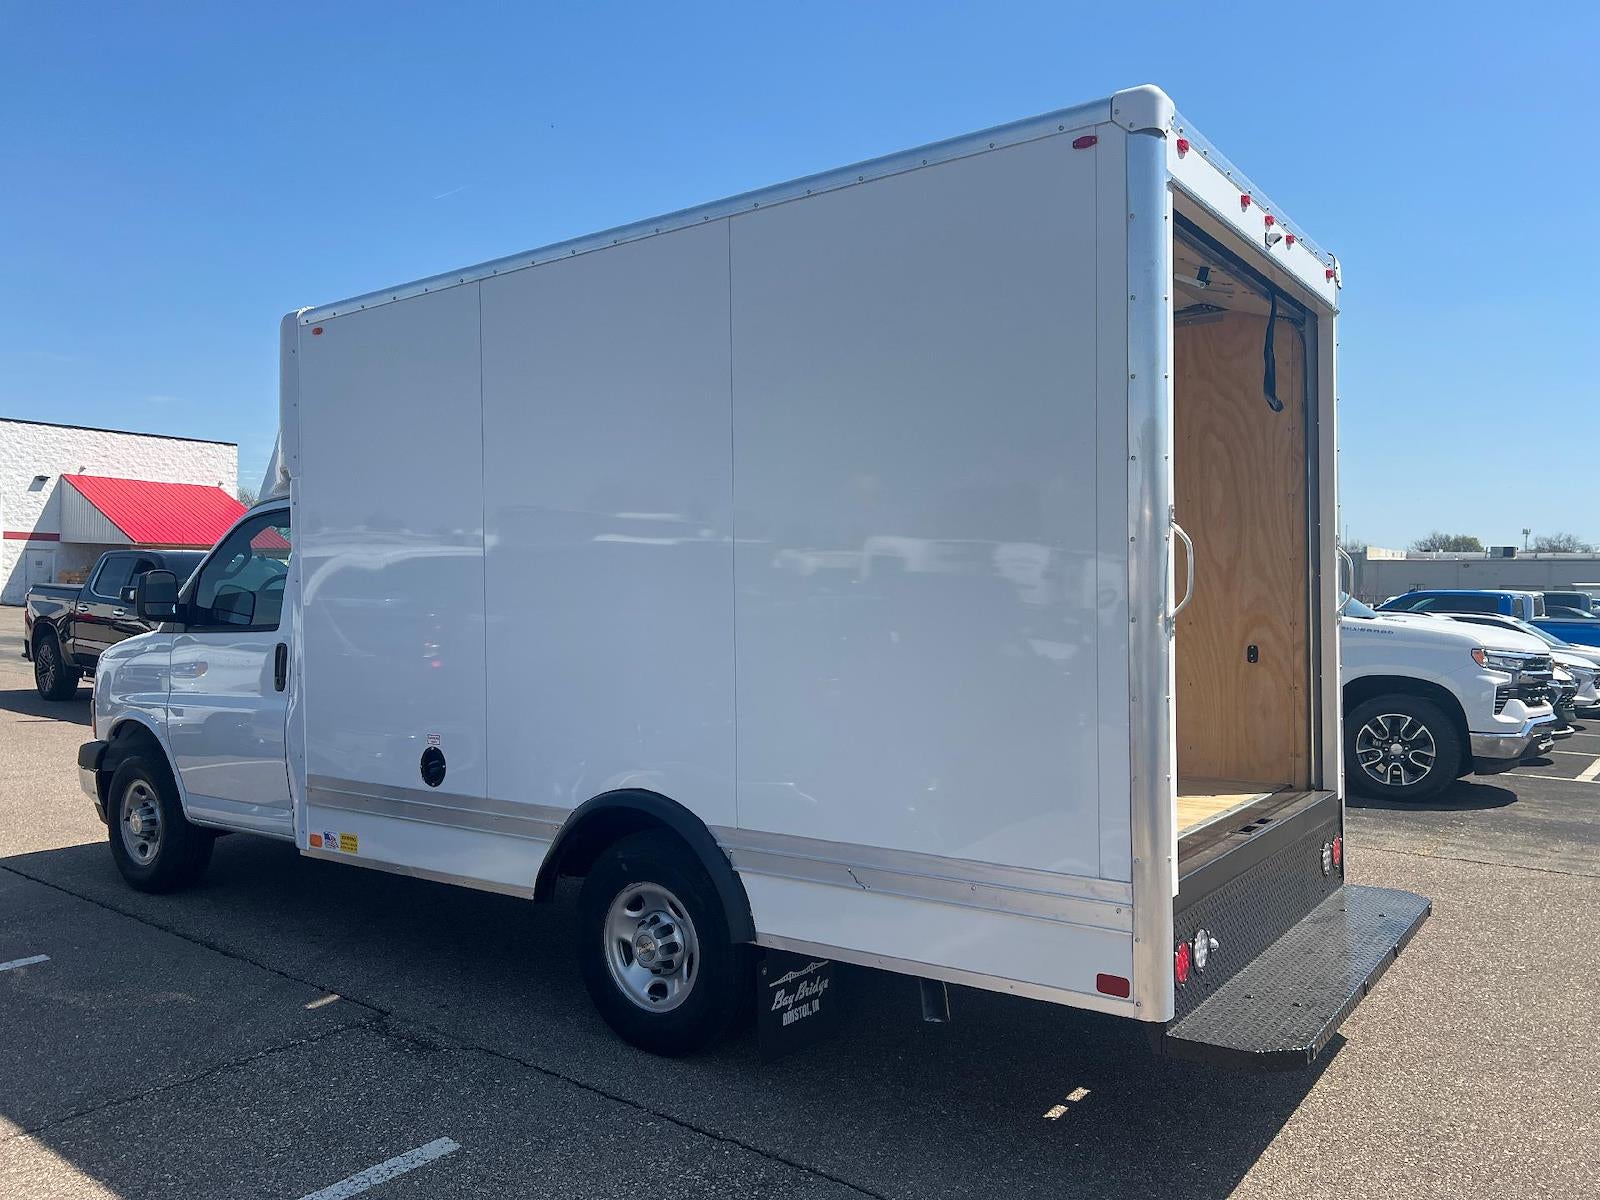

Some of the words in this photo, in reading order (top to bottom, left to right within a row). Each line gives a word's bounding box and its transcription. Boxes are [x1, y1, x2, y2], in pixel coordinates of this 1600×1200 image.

[771, 988, 795, 1011] Bay
[794, 976, 829, 1002] Bridge
[783, 1003, 812, 1026] BRISTOL,
[812, 999, 819, 1013] IN
